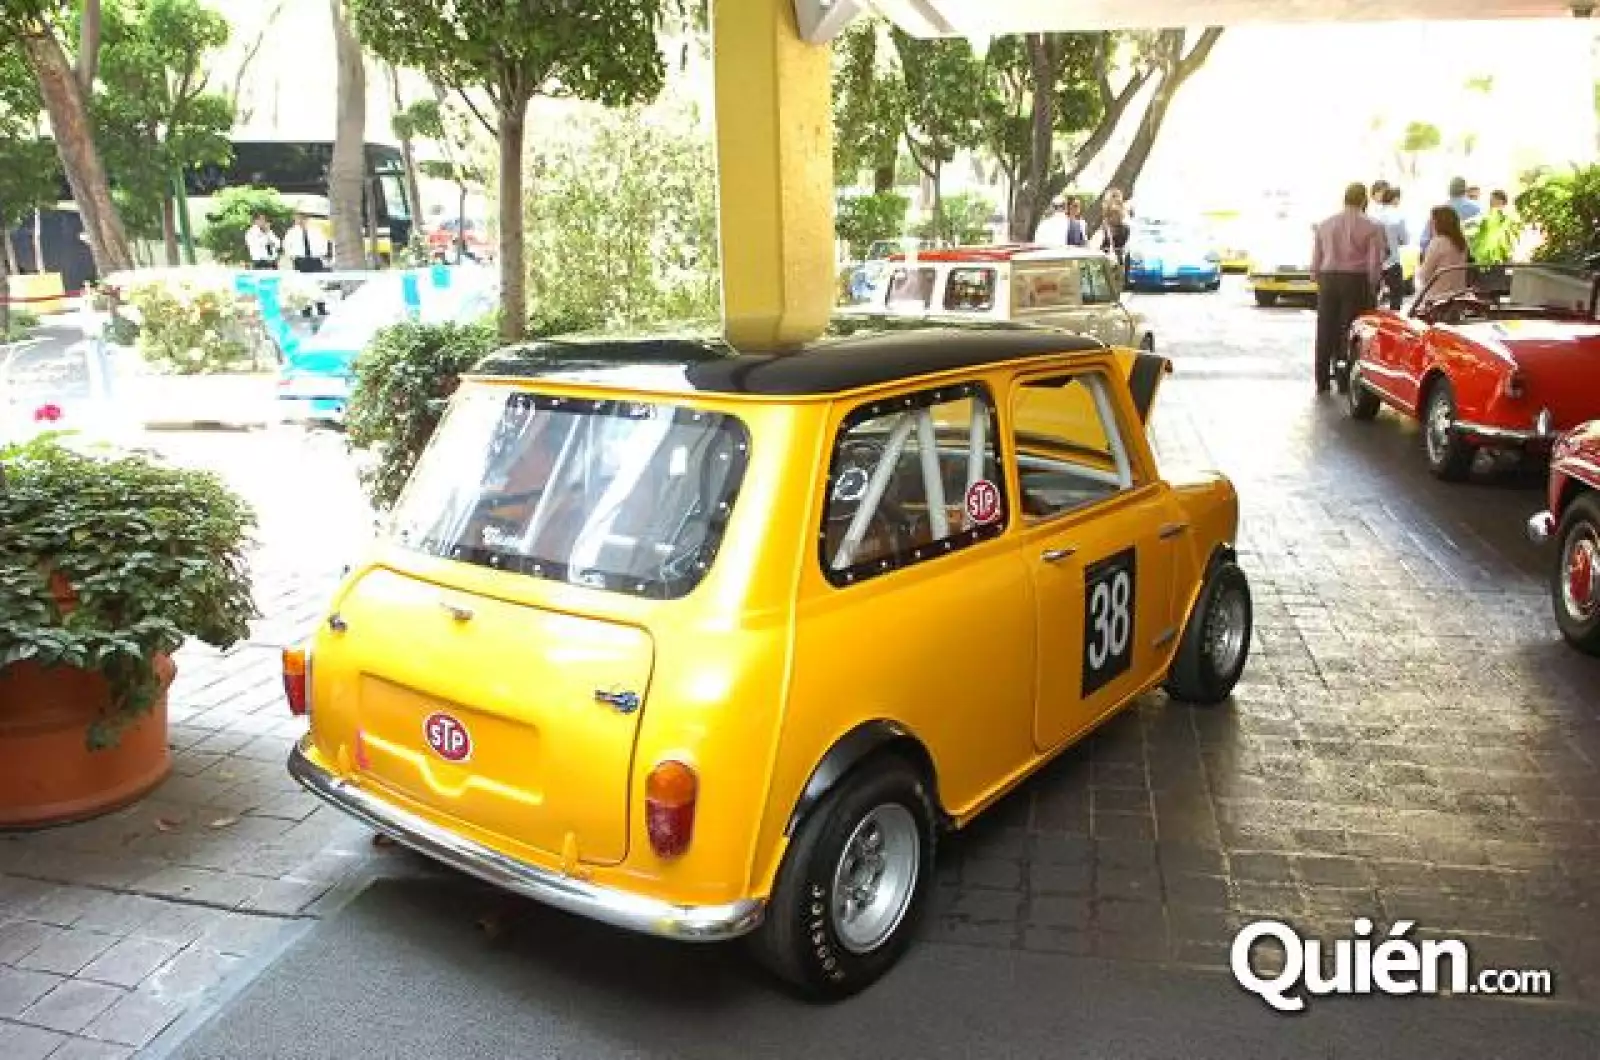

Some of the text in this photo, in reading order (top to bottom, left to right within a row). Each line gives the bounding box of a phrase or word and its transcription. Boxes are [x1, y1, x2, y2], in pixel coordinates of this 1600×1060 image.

[969, 484, 994, 516] STP
[1089, 570, 1129, 670] 38
[430, 717, 464, 751] STP
